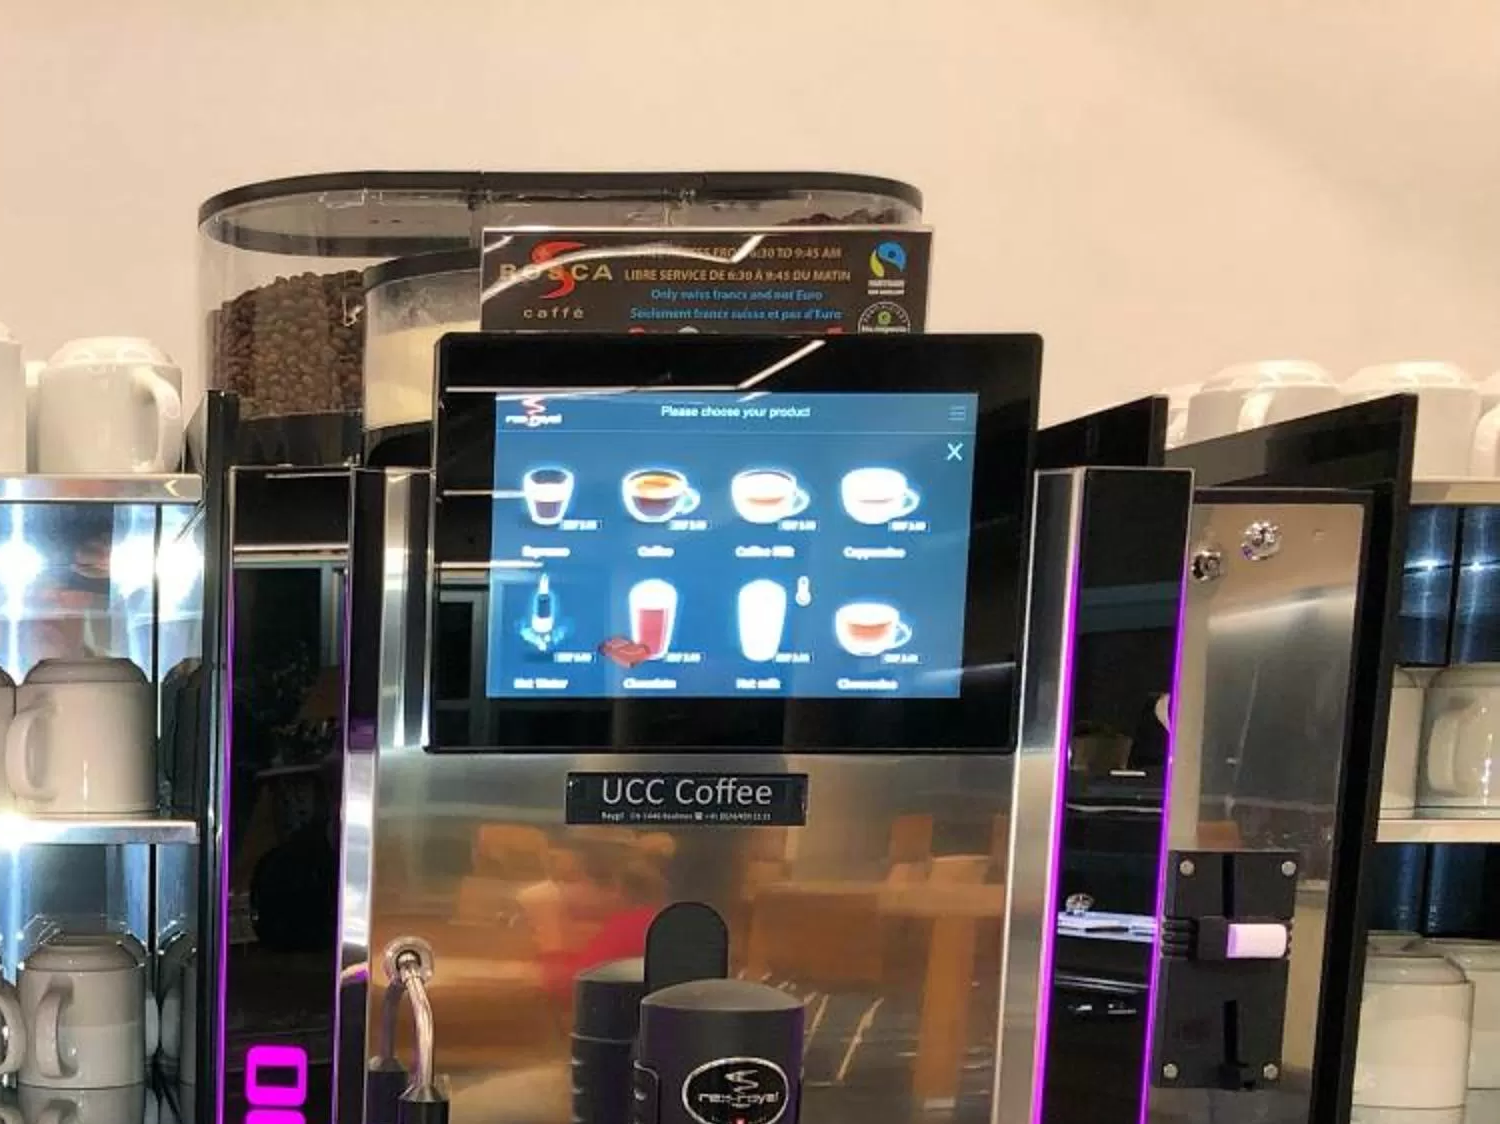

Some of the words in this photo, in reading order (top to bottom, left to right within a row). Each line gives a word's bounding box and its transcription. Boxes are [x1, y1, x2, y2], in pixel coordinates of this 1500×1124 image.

[777, 247, 793, 259] TO
[821, 247, 843, 259] AM
[624, 269, 657, 281] LIBRE
[659, 269, 707, 281] SERVICE
[709, 269, 726, 281] DE
[793, 270, 811, 281] DU
[813, 270, 851, 281] MATIN
[651, 287, 678, 302] Only
[795, 288, 824, 300] Euro
[661, 405, 699, 418] Please
[701, 405, 740, 418] choose
[741, 407, 766, 420] your
[769, 406, 812, 420] product
[602, 778, 665, 804] UCC
[675, 778, 773, 804] Coffee
